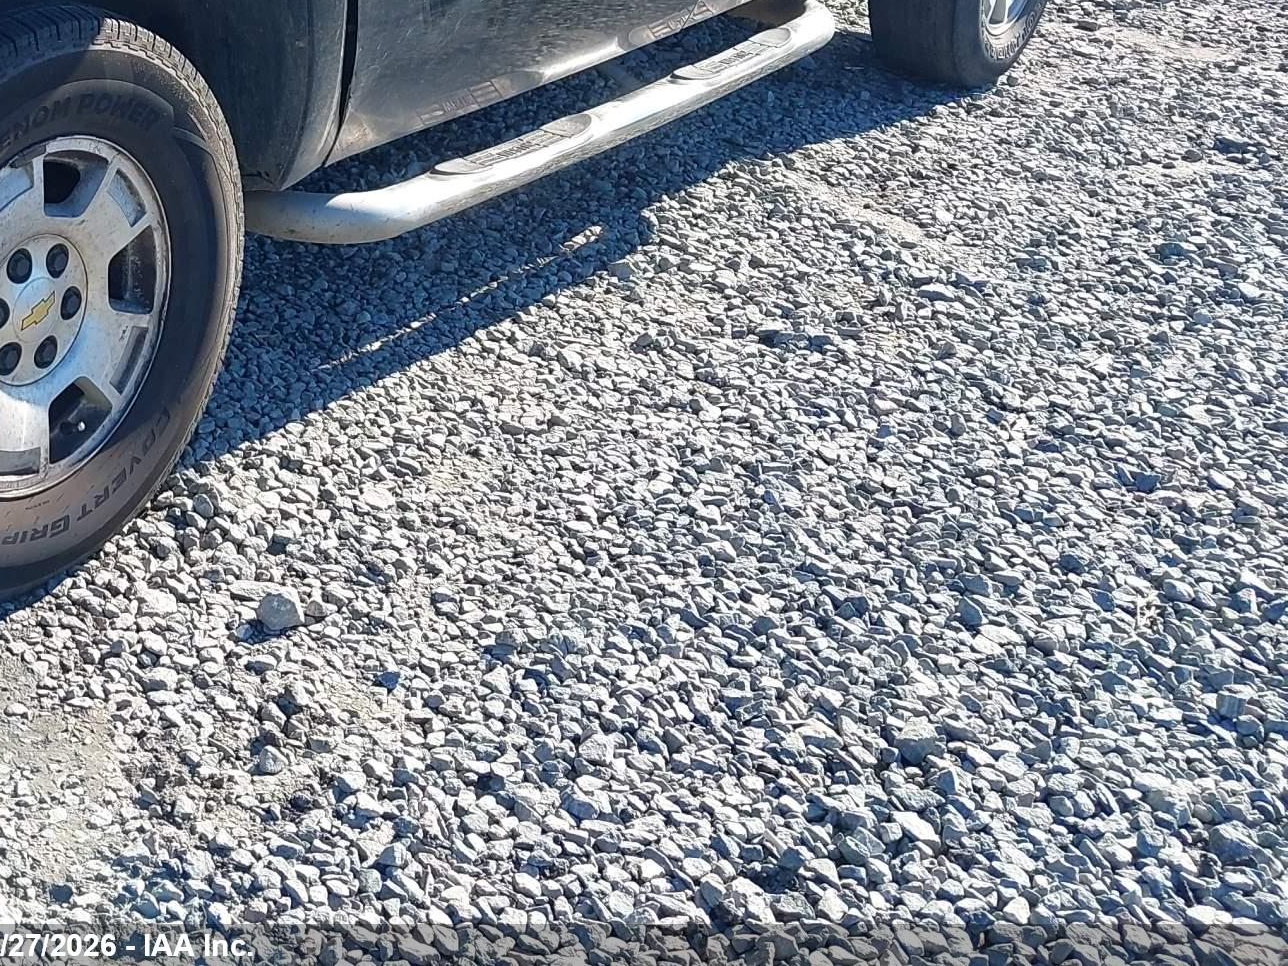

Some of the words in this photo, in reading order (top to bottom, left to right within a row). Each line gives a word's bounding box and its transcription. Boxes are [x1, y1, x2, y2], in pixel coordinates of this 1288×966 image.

[75, 92, 161, 130] POWER
[77, 406, 171, 522] COVERT
[2, 514, 71, 546] GRIP
